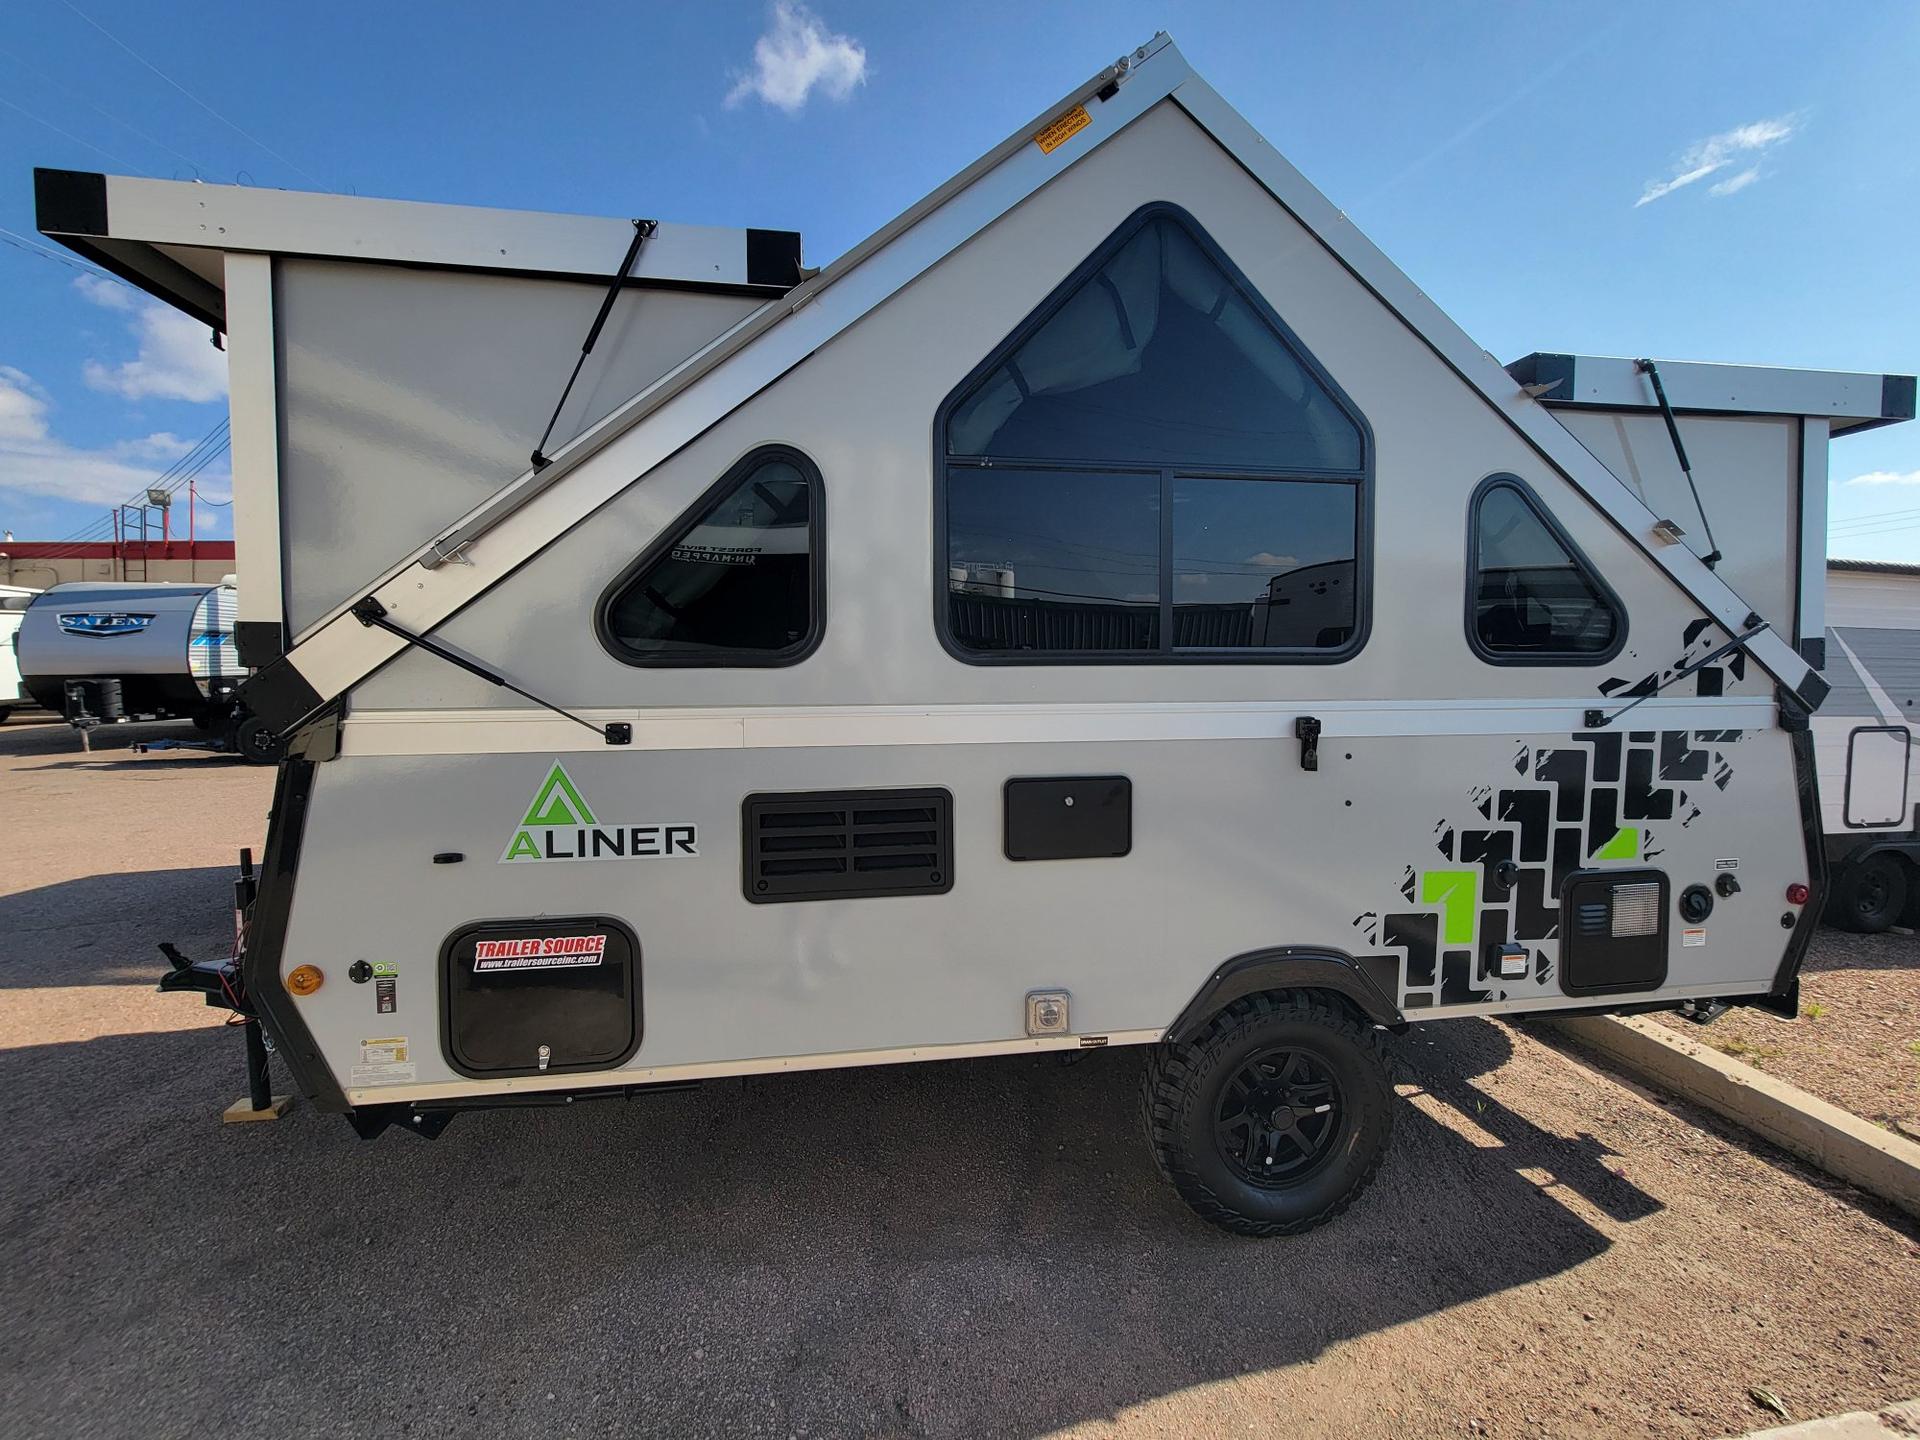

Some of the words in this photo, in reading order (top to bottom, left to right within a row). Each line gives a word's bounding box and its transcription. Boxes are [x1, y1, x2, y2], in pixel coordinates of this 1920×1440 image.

[1039, 129, 1057, 144] WHEN
[1056, 109, 1085, 132] ERECTING
[1052, 130, 1067, 143] HIGH
[1066, 116, 1086, 132] WINDS
[61, 617, 151, 626] SALEM
[506, 827, 696, 860] ALINER
[477, 939, 541, 957] TRAILER
[543, 936, 605, 954] SOURCE
[480, 954, 597, 969] www.trailersourceinc.com
